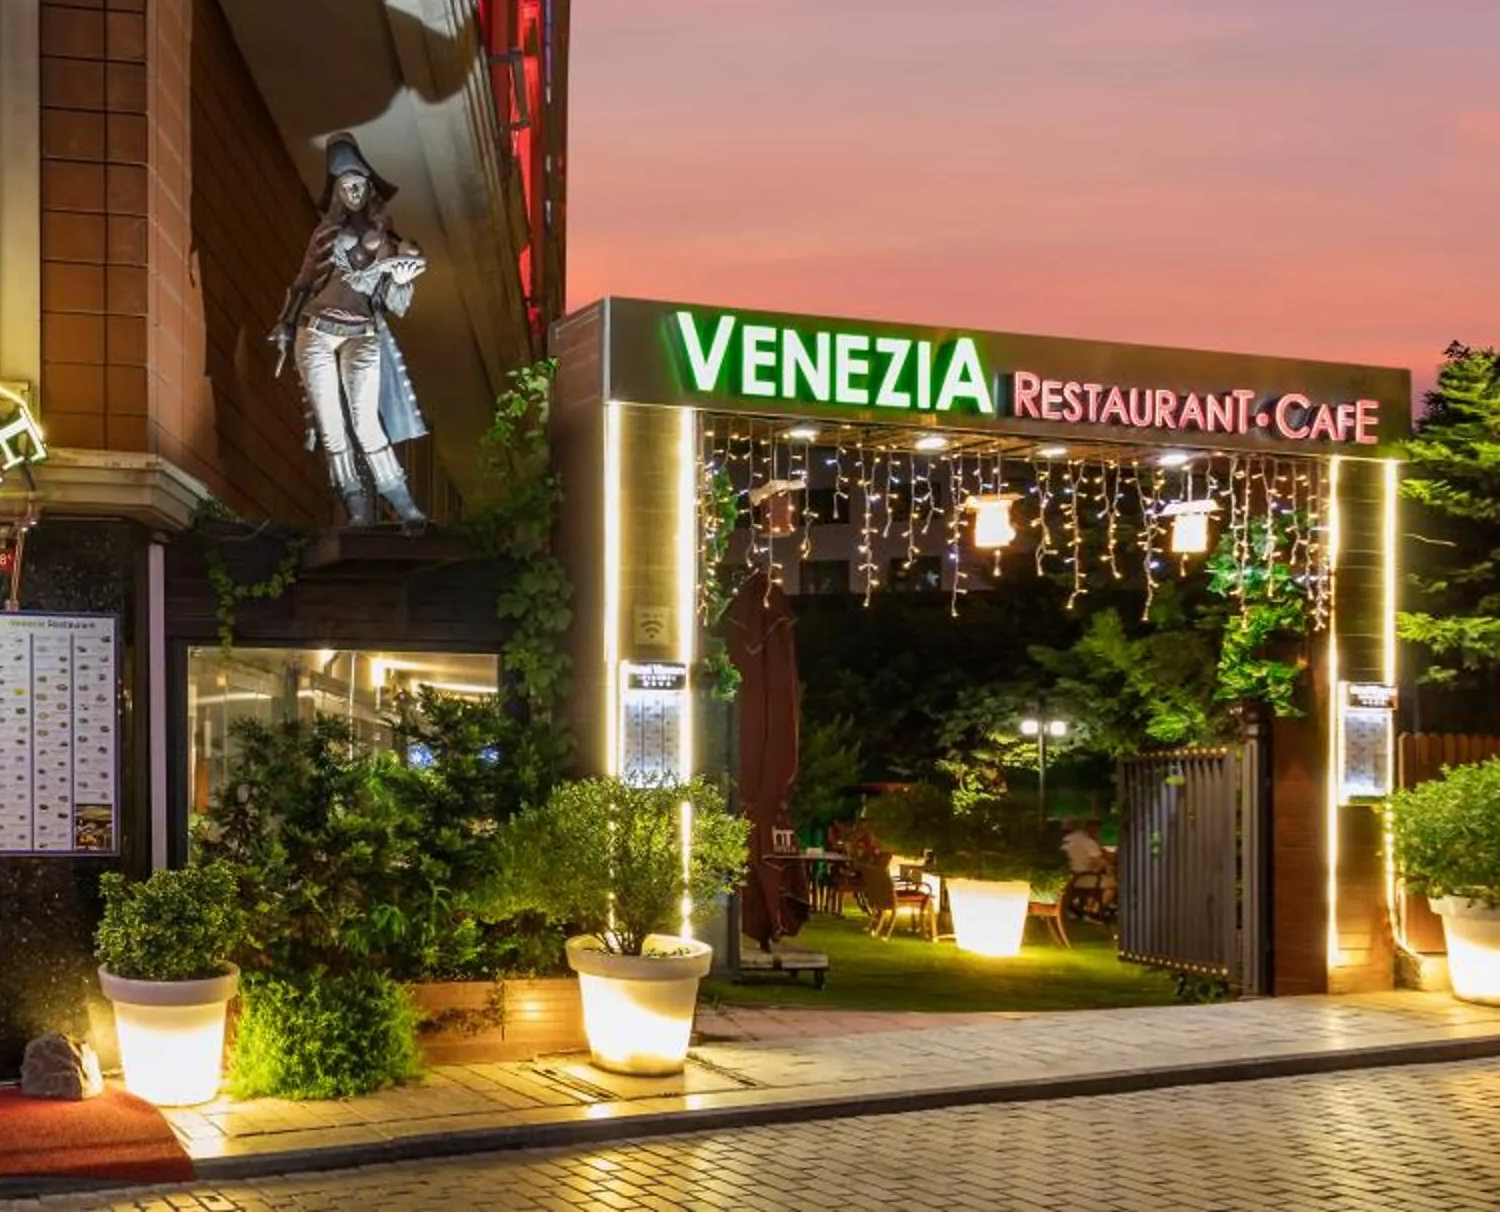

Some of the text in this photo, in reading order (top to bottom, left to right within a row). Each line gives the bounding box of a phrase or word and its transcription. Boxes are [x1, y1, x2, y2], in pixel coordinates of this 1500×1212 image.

[676, 311, 1380, 446] VENEZIA RESTAURANT CAFE
